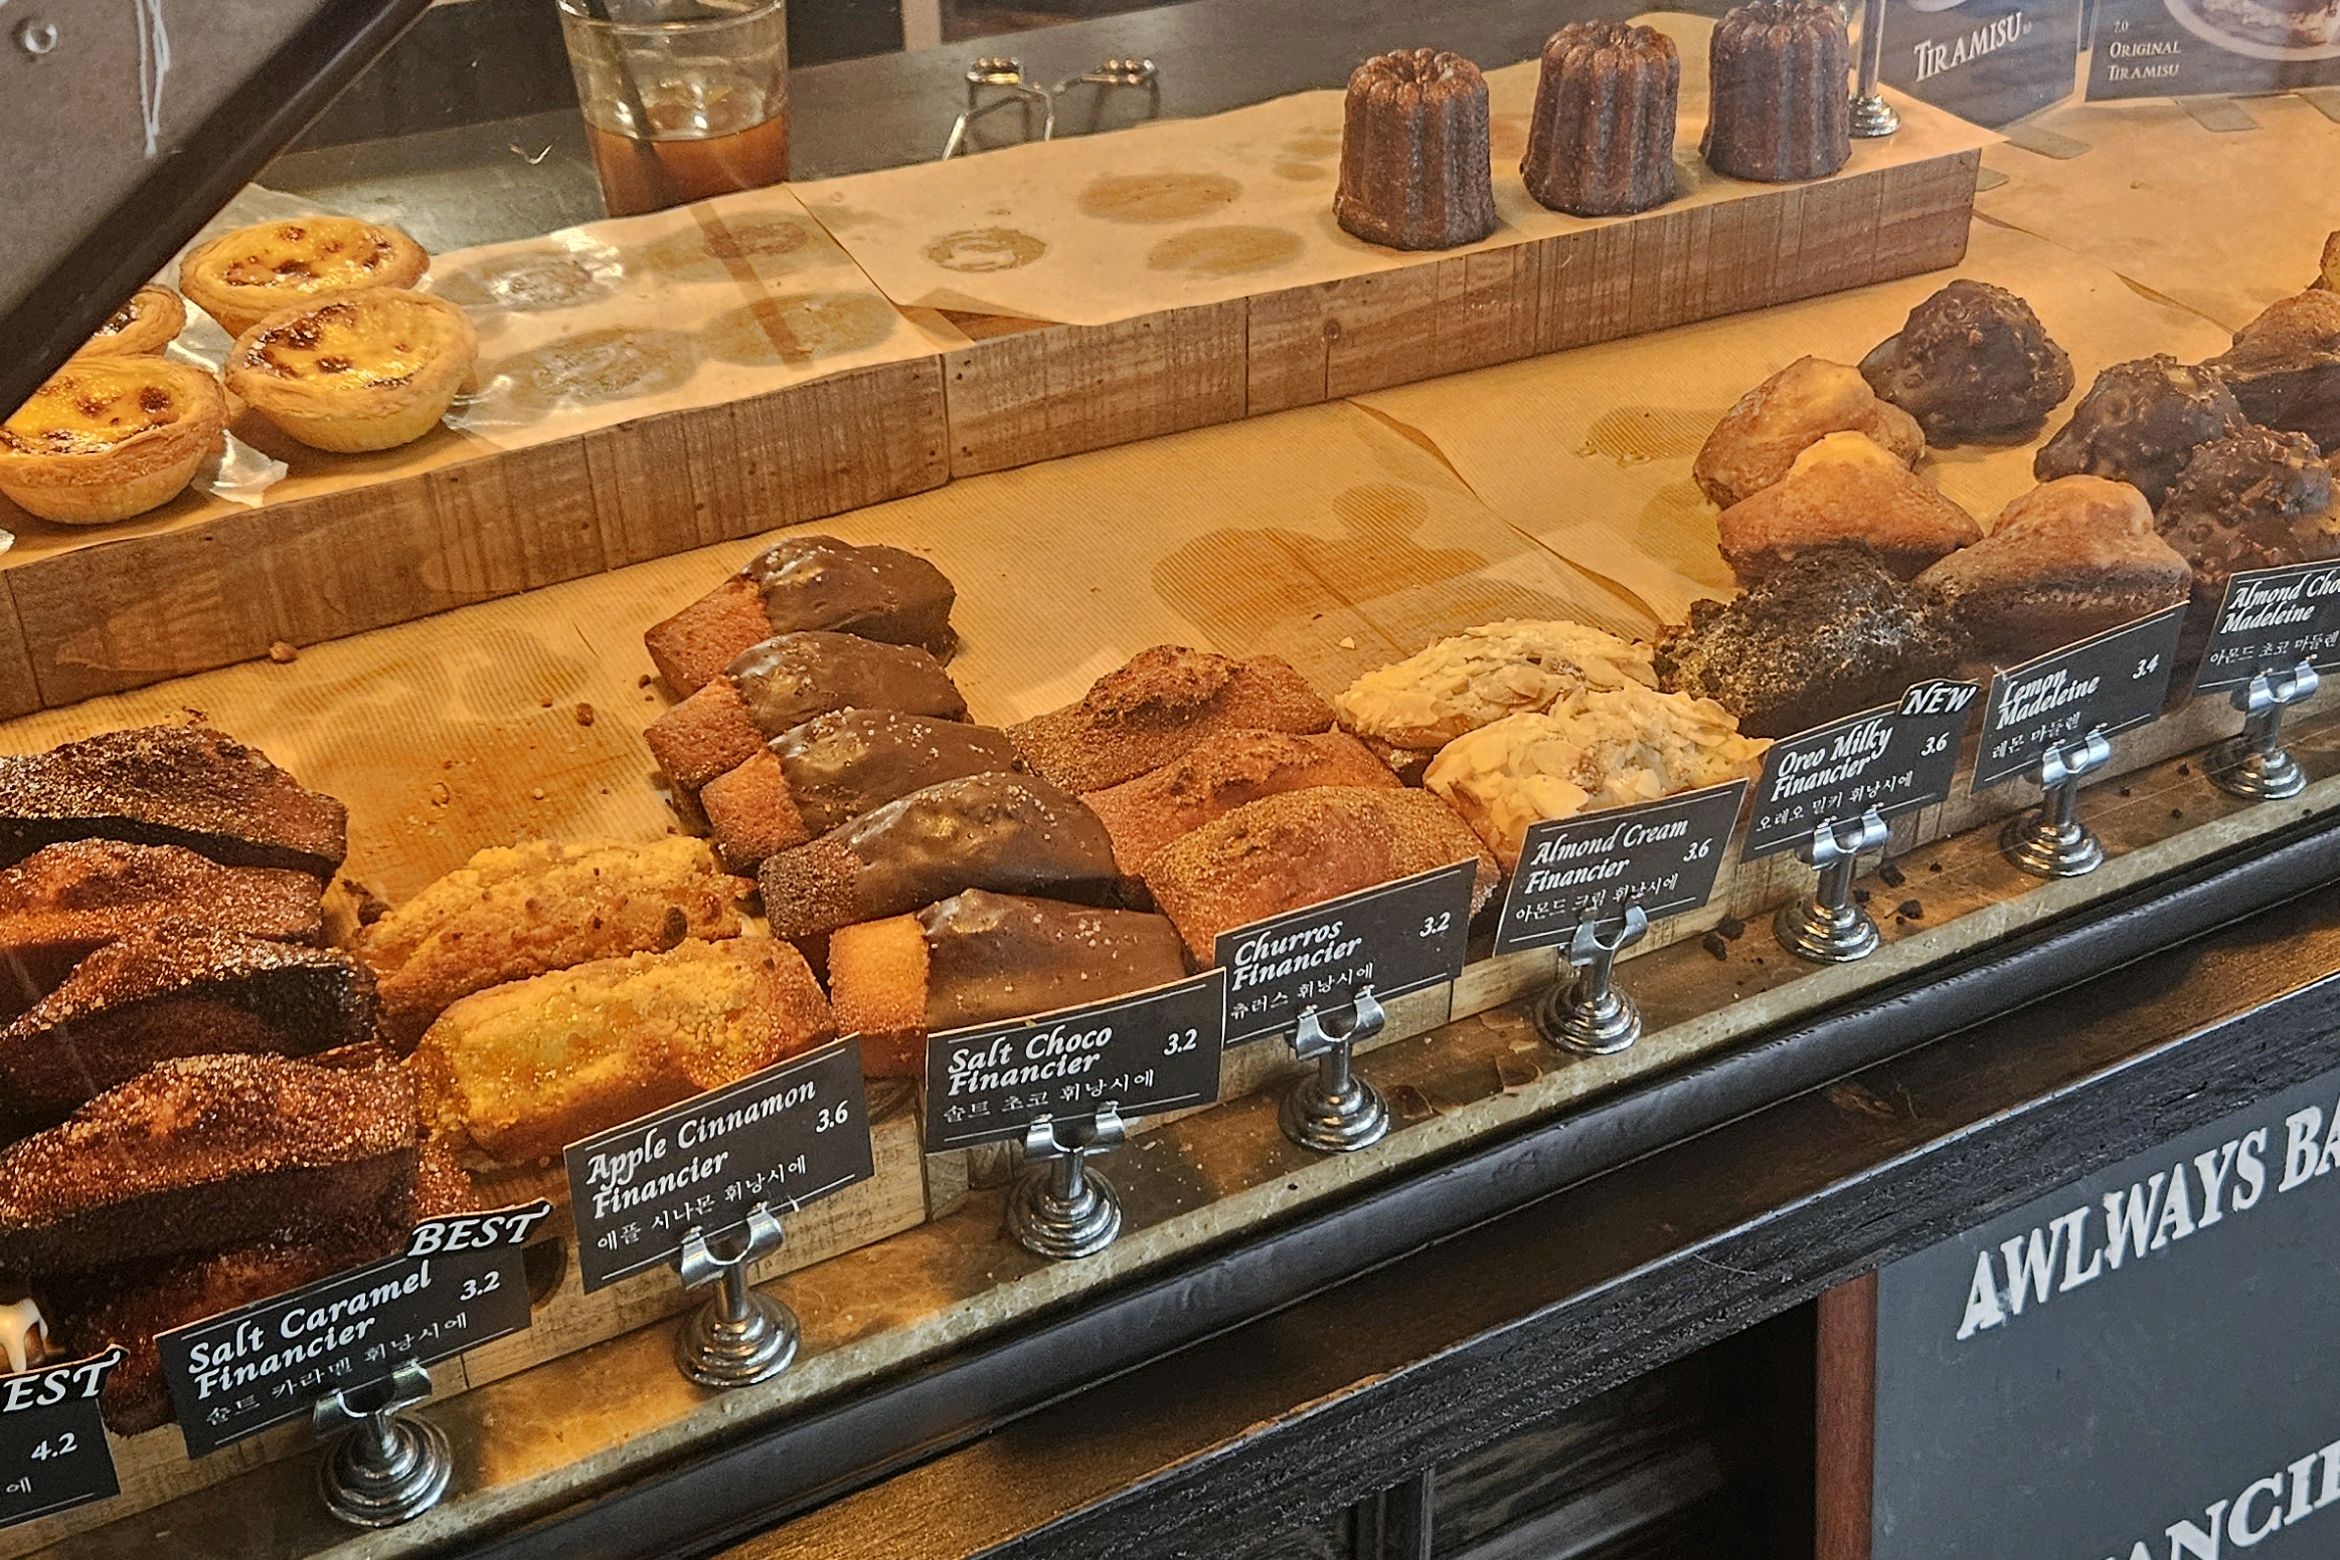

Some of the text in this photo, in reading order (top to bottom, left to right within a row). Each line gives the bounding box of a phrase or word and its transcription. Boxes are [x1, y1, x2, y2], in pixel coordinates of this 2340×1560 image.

[1913, 12, 2022, 82] TIRAMISU
[2109, 40, 2182, 58] ORIGINAL
[2107, 64, 2181, 81] TIRAMISU
[2228, 573, 2312, 610] Almond
[2220, 601, 2315, 634] Madeleine
[2132, 654, 2160, 680] 3.4
[2210, 645, 2255, 666] 아몬드
[2259, 641, 2290, 657] 초코
[1902, 682, 1977, 716] NEW
[1995, 675, 2100, 730] Madeleine
[1998, 668, 2068, 710] Lemon
[1777, 718, 1894, 778] Oreo Milky
[1921, 732, 1950, 757] 3.6
[1992, 735, 2025, 759] 레몬
[1756, 770, 1914, 832] 오레오 밀키 휘낭시에
[1771, 756, 1870, 802] Financier
[1531, 819, 1689, 866] Almond Cream
[1683, 839, 1713, 863] 3.6
[1524, 858, 1630, 895] Financier
[1419, 911, 1452, 938] 3.2
[1516, 899, 1566, 923] 아몬드
[1232, 937, 1363, 991] Financier
[1234, 920, 1344, 966] Churros
[1230, 962, 1374, 1020] 츄러스 휘낭시에
[948, 1025, 1113, 1074] Salt Choco
[1164, 1029, 1198, 1056] 3.2
[948, 1052, 1101, 1096] Financier
[1002, 1093, 1049, 1112] 초코
[1060, 1069, 1154, 1101] 휘낭시에
[586, 1080, 816, 1194] Apple Cinnamon
[815, 1100, 849, 1133] 3.6
[592, 1151, 729, 1219] Financier
[651, 1195, 715, 1230] 시나몬
[725, 1155, 806, 1201] 휘낭시에
[407, 1205, 552, 1258] BEST
[1956, 1127, 2268, 1340] AWLWAYS
[459, 1272, 500, 1301] 3.2
[187, 1261, 431, 1374] Salt Caramel
[364, 1312, 467, 1362] 휘낭시에
[193, 1315, 377, 1401] Financier
[3, 1350, 120, 1412] EST
[31, 1432, 78, 1461] 4.2
